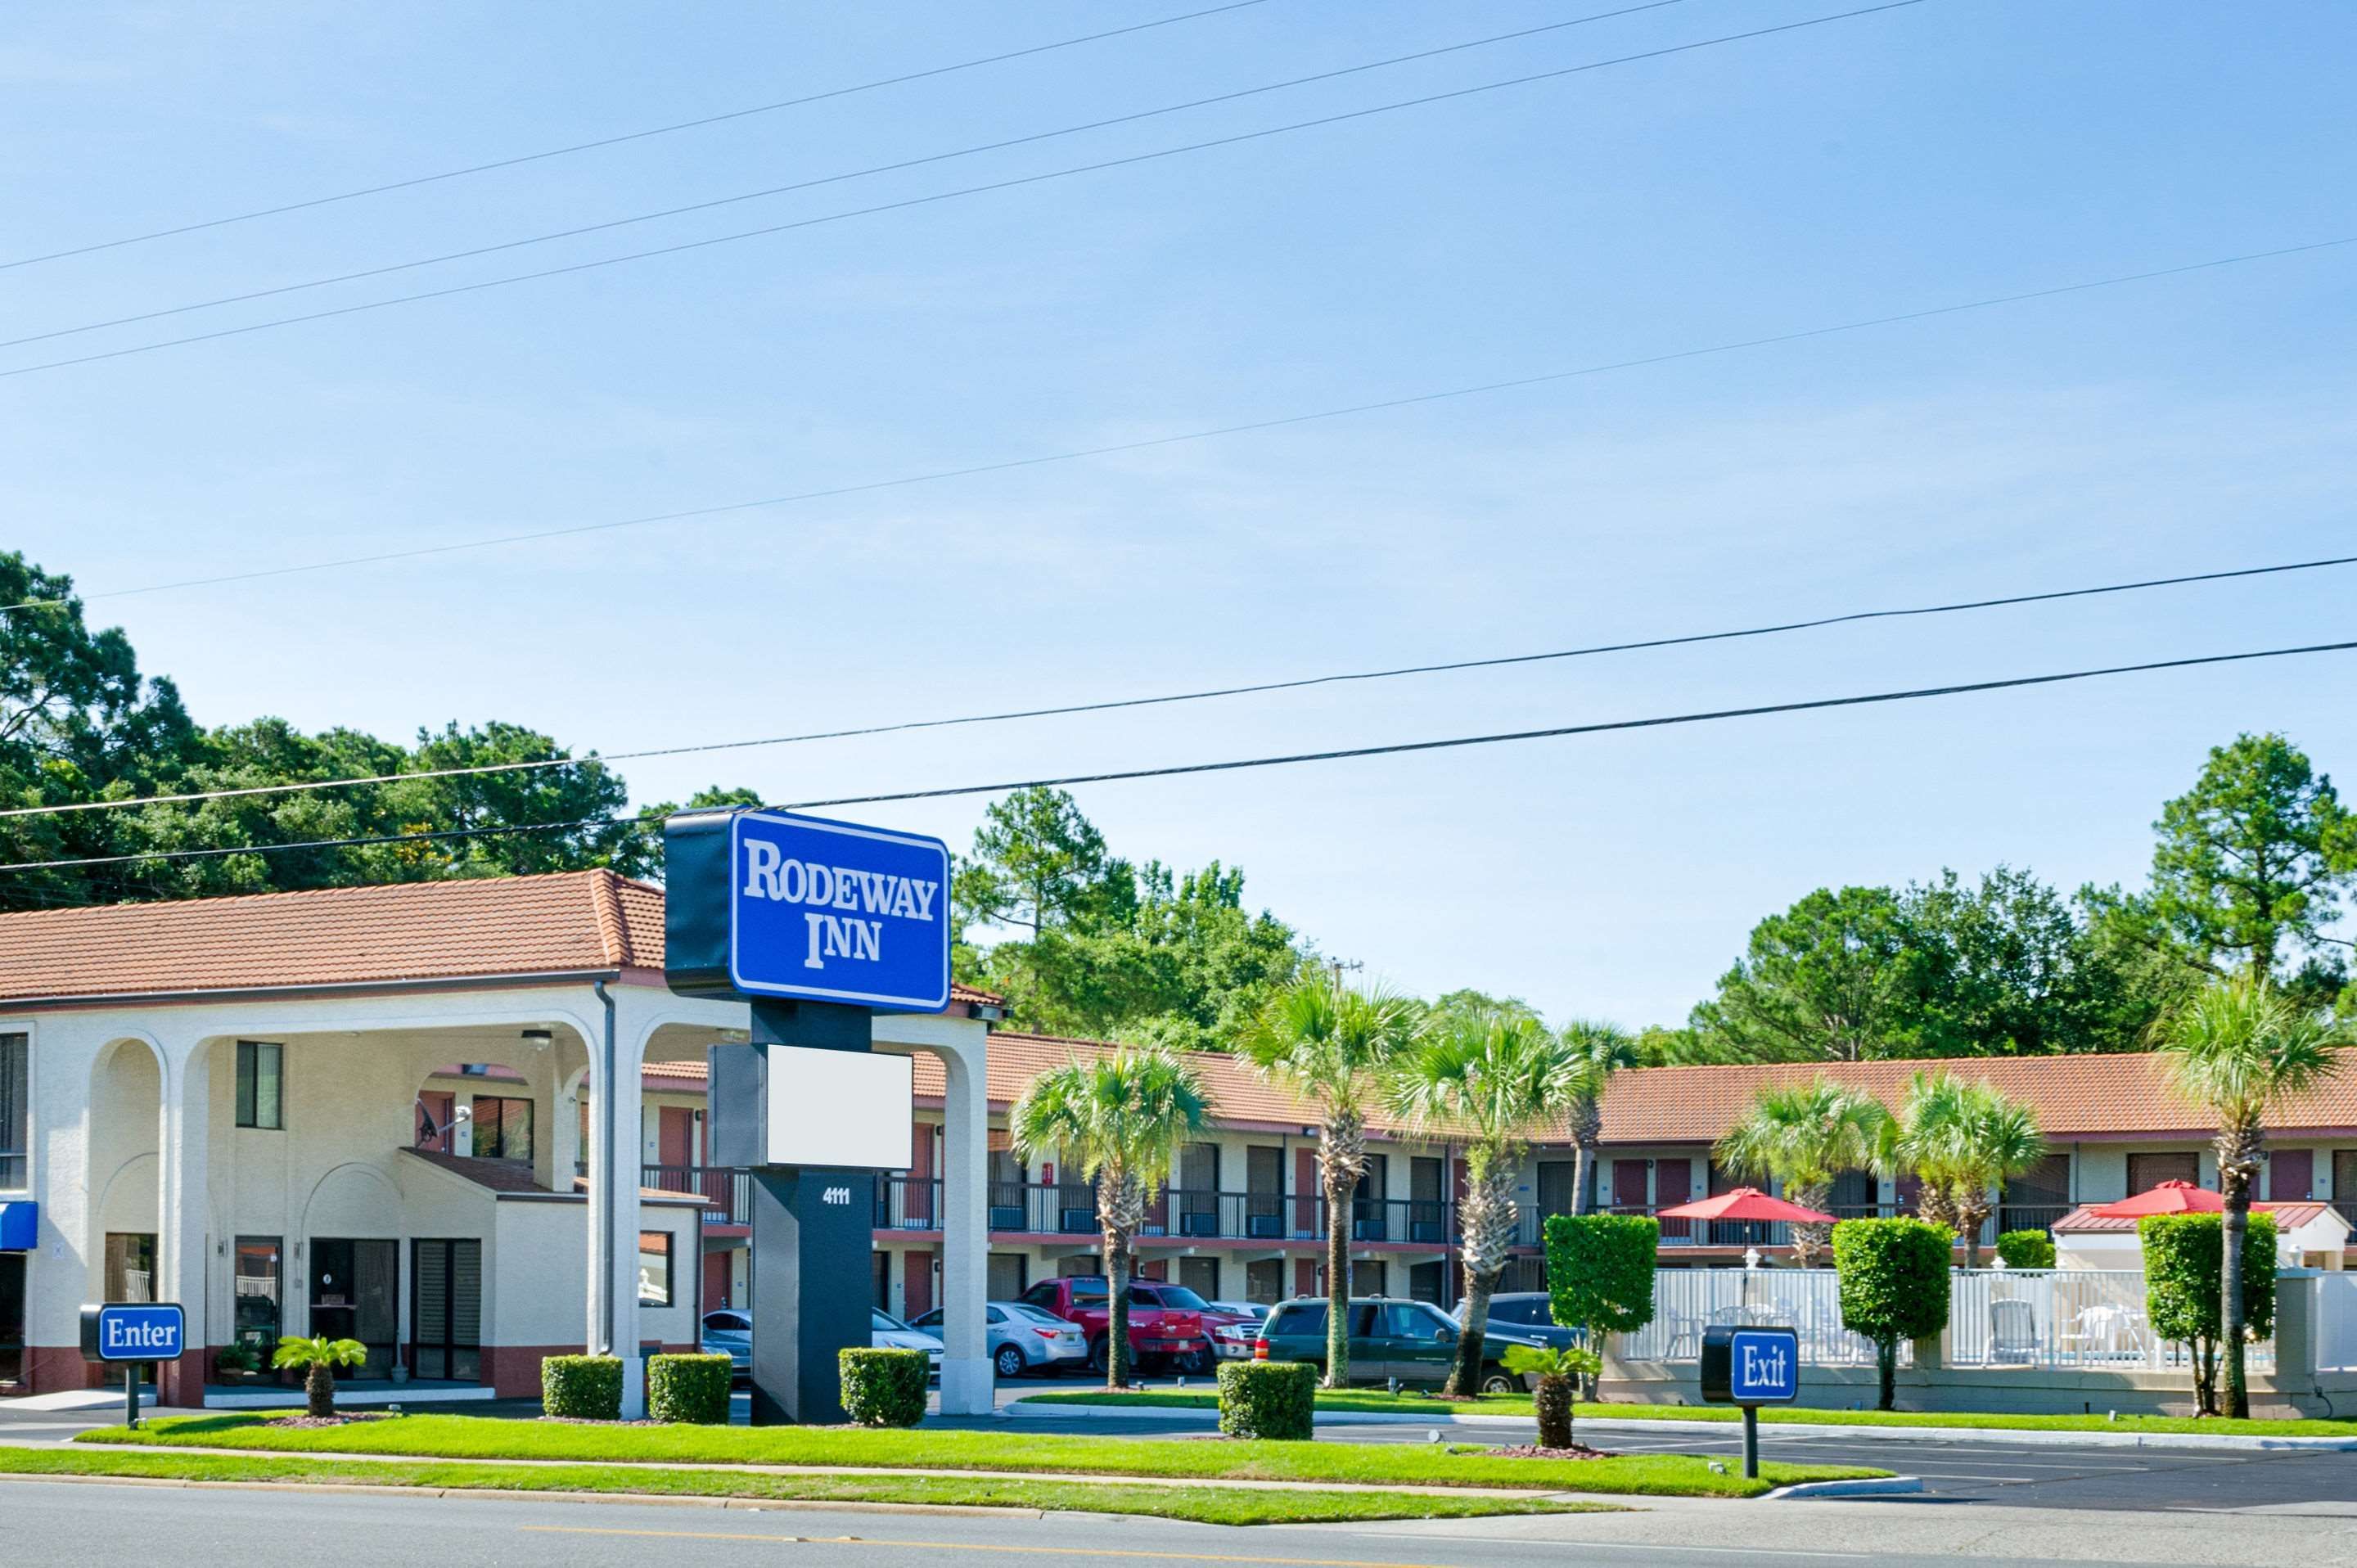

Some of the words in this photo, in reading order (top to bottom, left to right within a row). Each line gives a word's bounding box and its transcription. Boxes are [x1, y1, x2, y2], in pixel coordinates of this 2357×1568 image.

[743, 838, 939, 921] RODEWAY
[804, 913, 882, 969] INN
[822, 1187, 850, 1205] 4111
[107, 1318, 177, 1347] Enter
[1742, 1345, 1787, 1387] Exit
